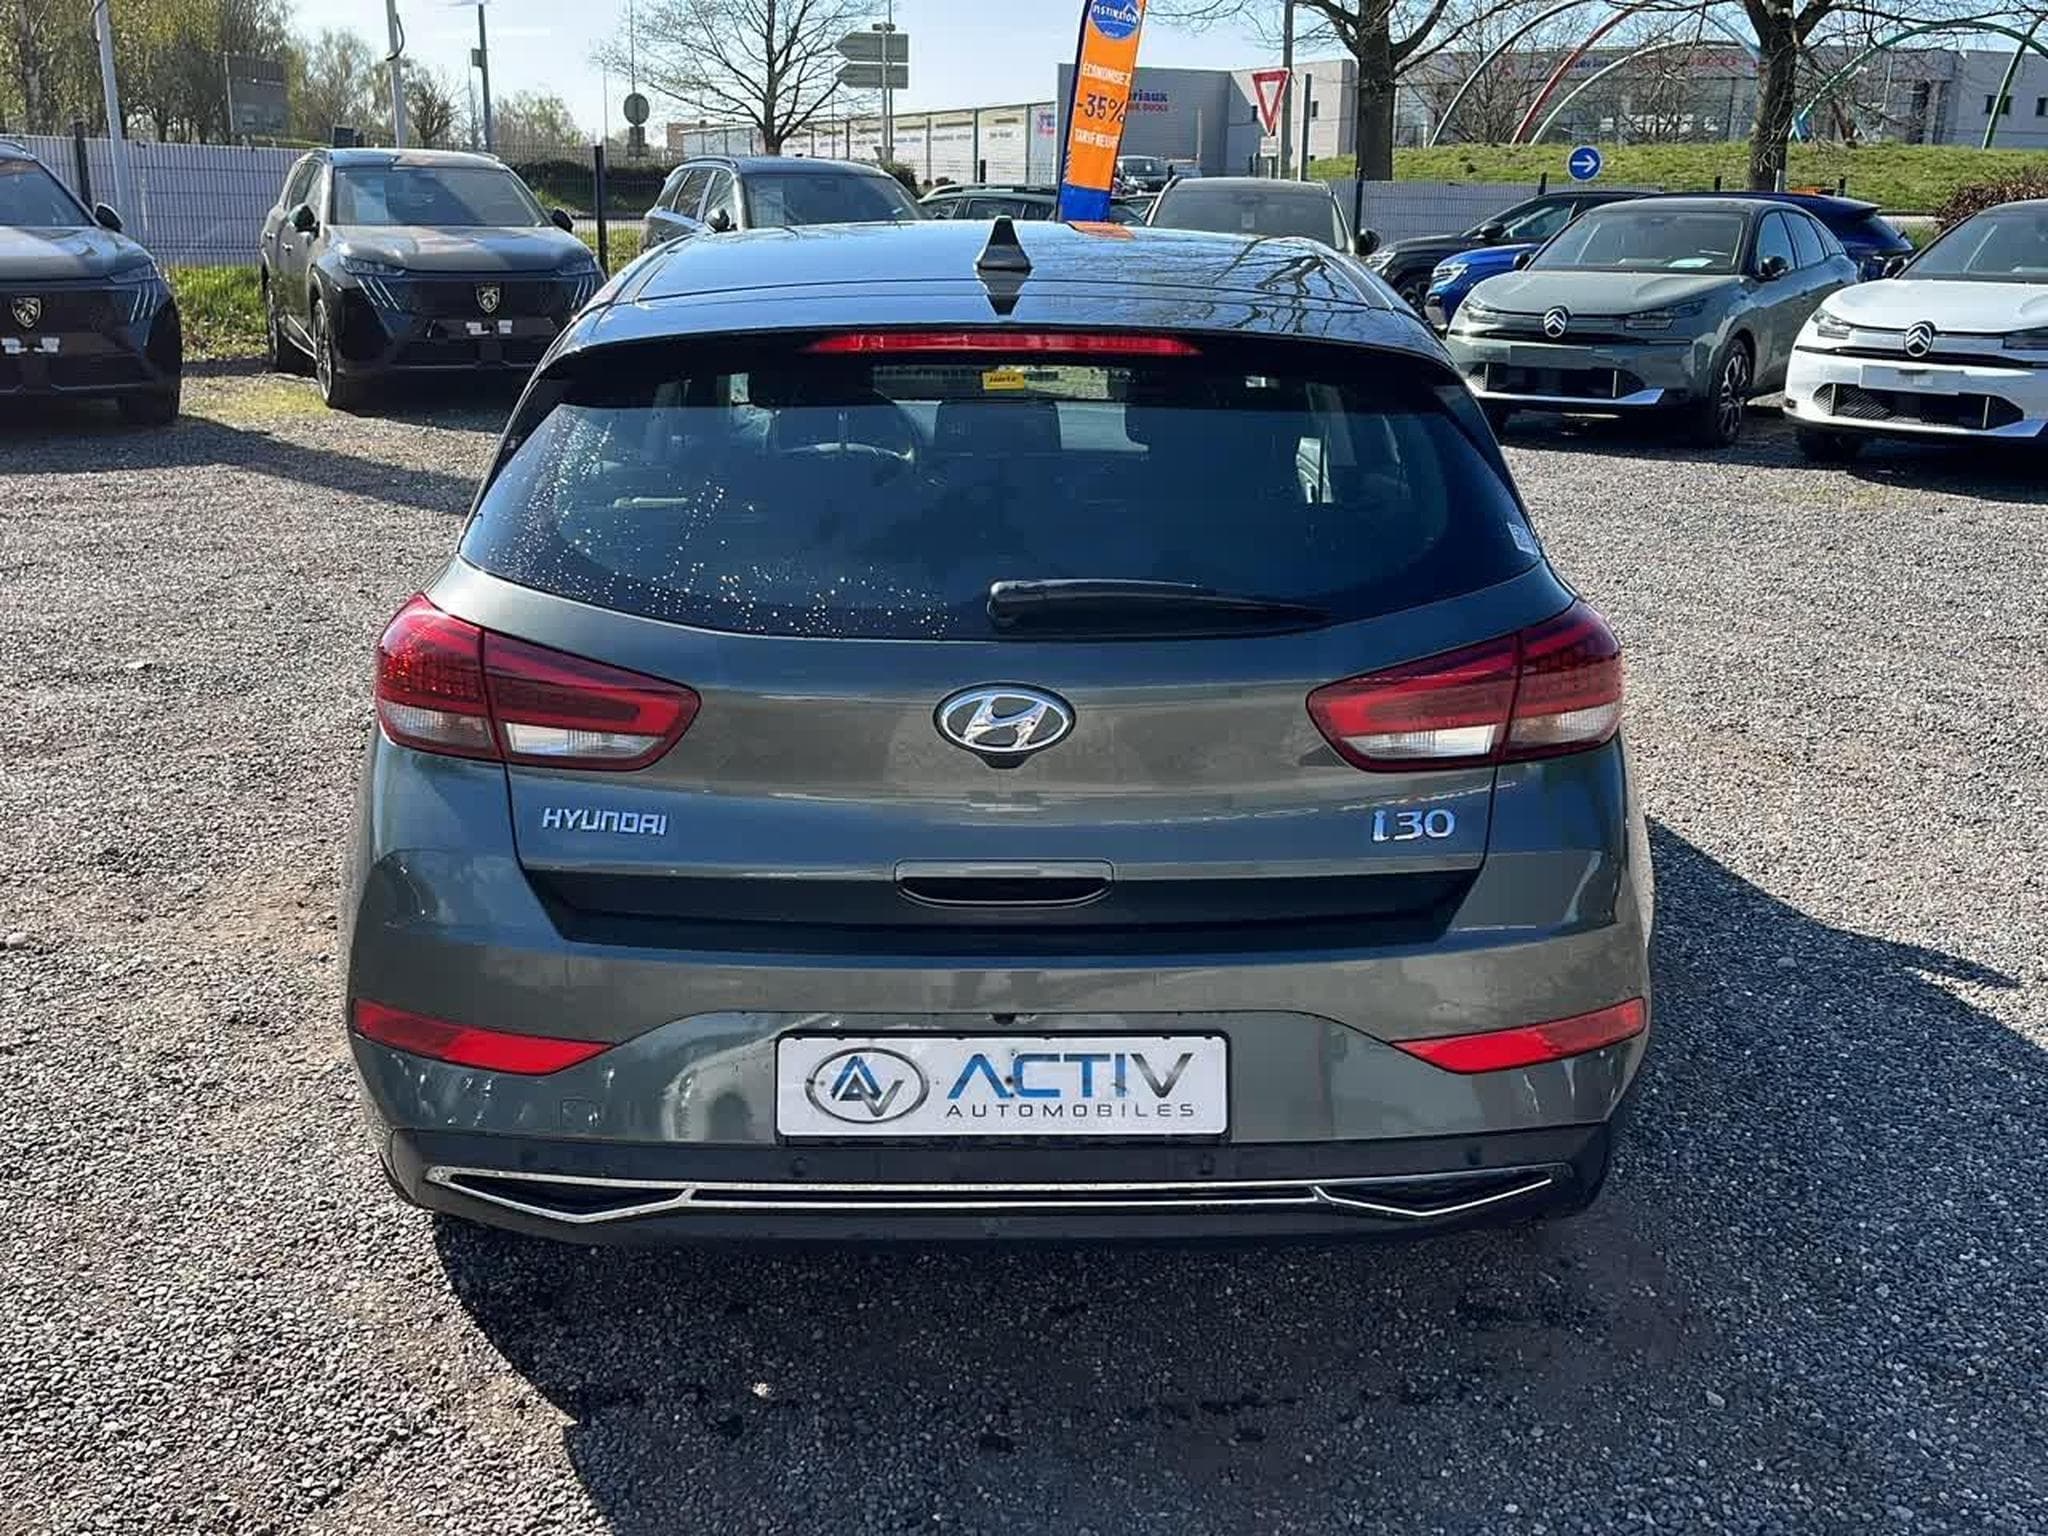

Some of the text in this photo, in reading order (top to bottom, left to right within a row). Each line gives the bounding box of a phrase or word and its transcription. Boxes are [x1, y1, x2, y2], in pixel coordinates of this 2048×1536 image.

[1077, 93, 1125, 123] -35%
[1132, 88, 1168, 102] riaux
[542, 807, 668, 836] HYUNDAI
[1372, 809, 1456, 842] i30
[946, 1052, 1194, 1099] ACTIV
[945, 1102, 1196, 1118] AUTOMOBILES
